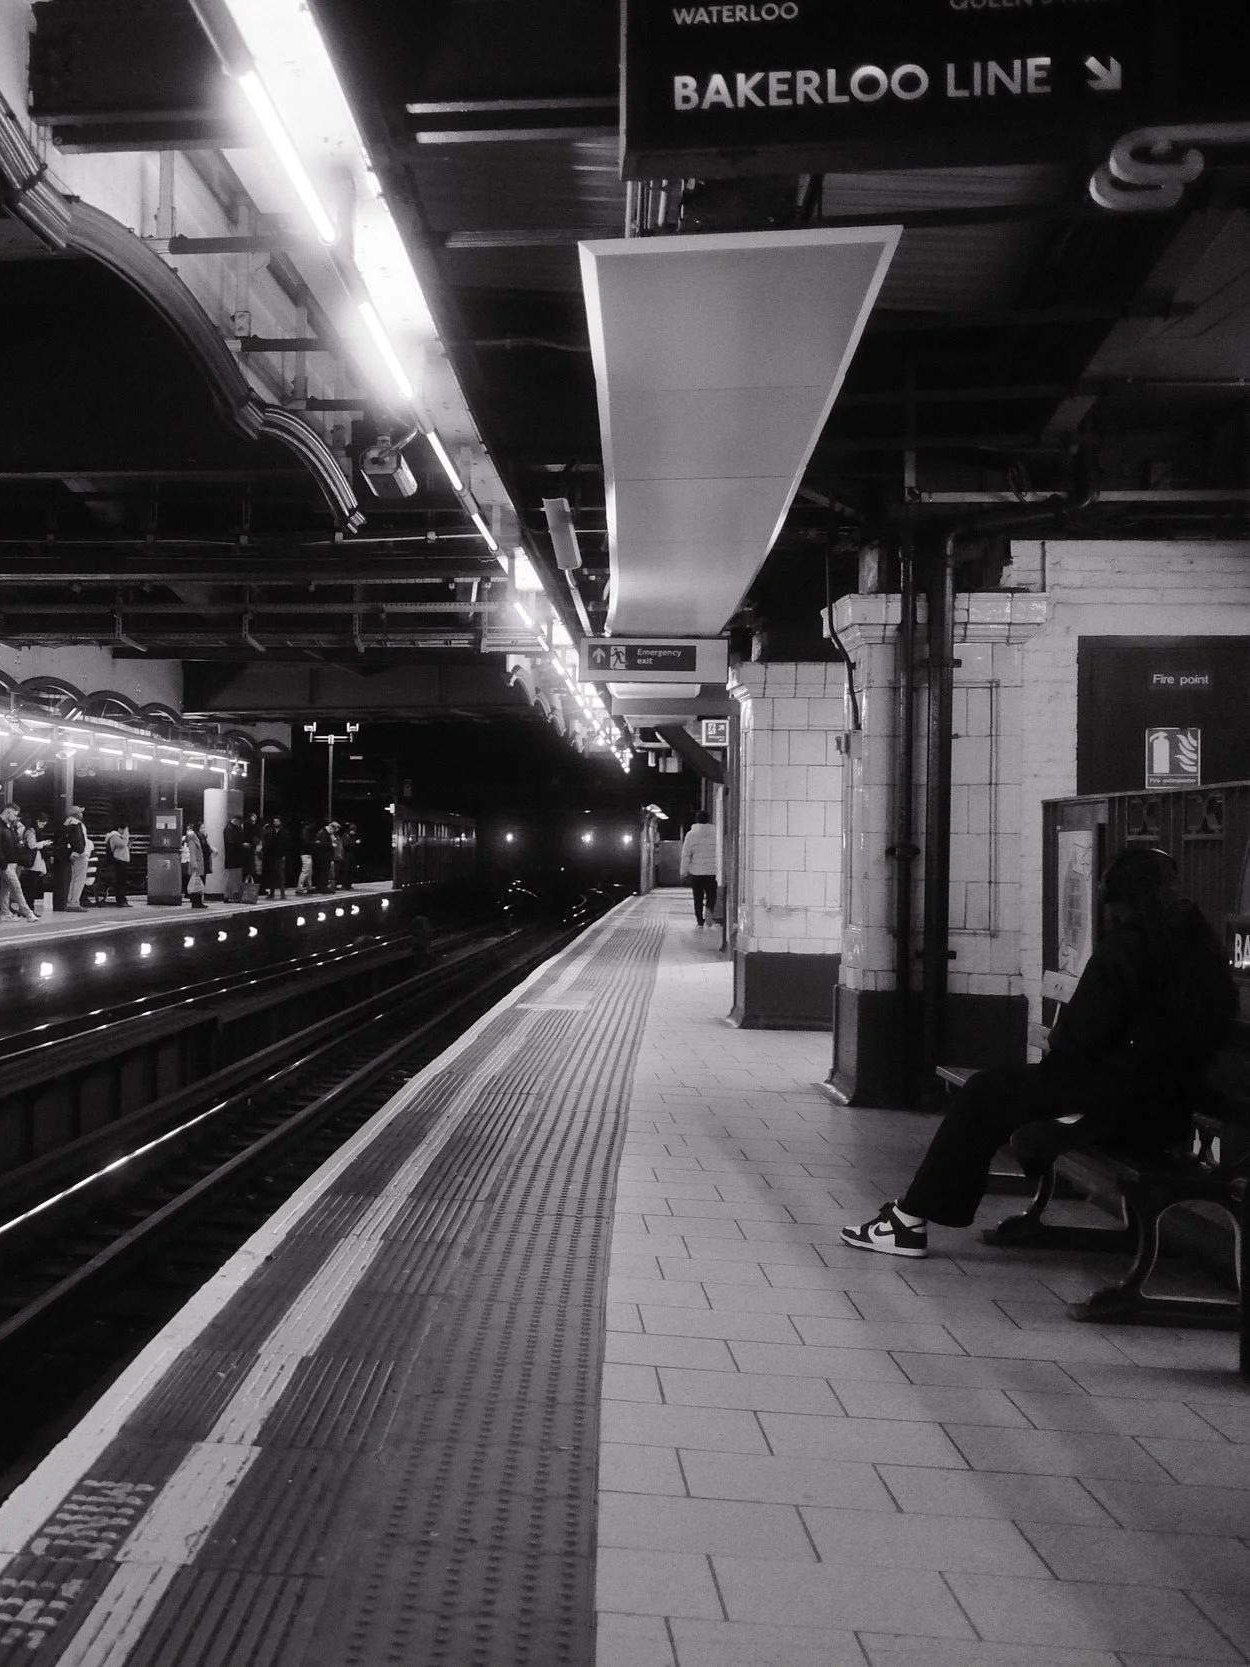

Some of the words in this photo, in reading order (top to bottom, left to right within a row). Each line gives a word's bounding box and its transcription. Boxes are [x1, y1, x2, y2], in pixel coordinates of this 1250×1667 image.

[672, 2, 799, 25] WATERLOO
[674, 64, 930, 110] BAKERLOO
[946, 57, 1051, 98] LINE
[637, 648, 682, 658] Emergency
[1153, 674, 1175, 684] Fire
[1180, 674, 1209, 686] point
